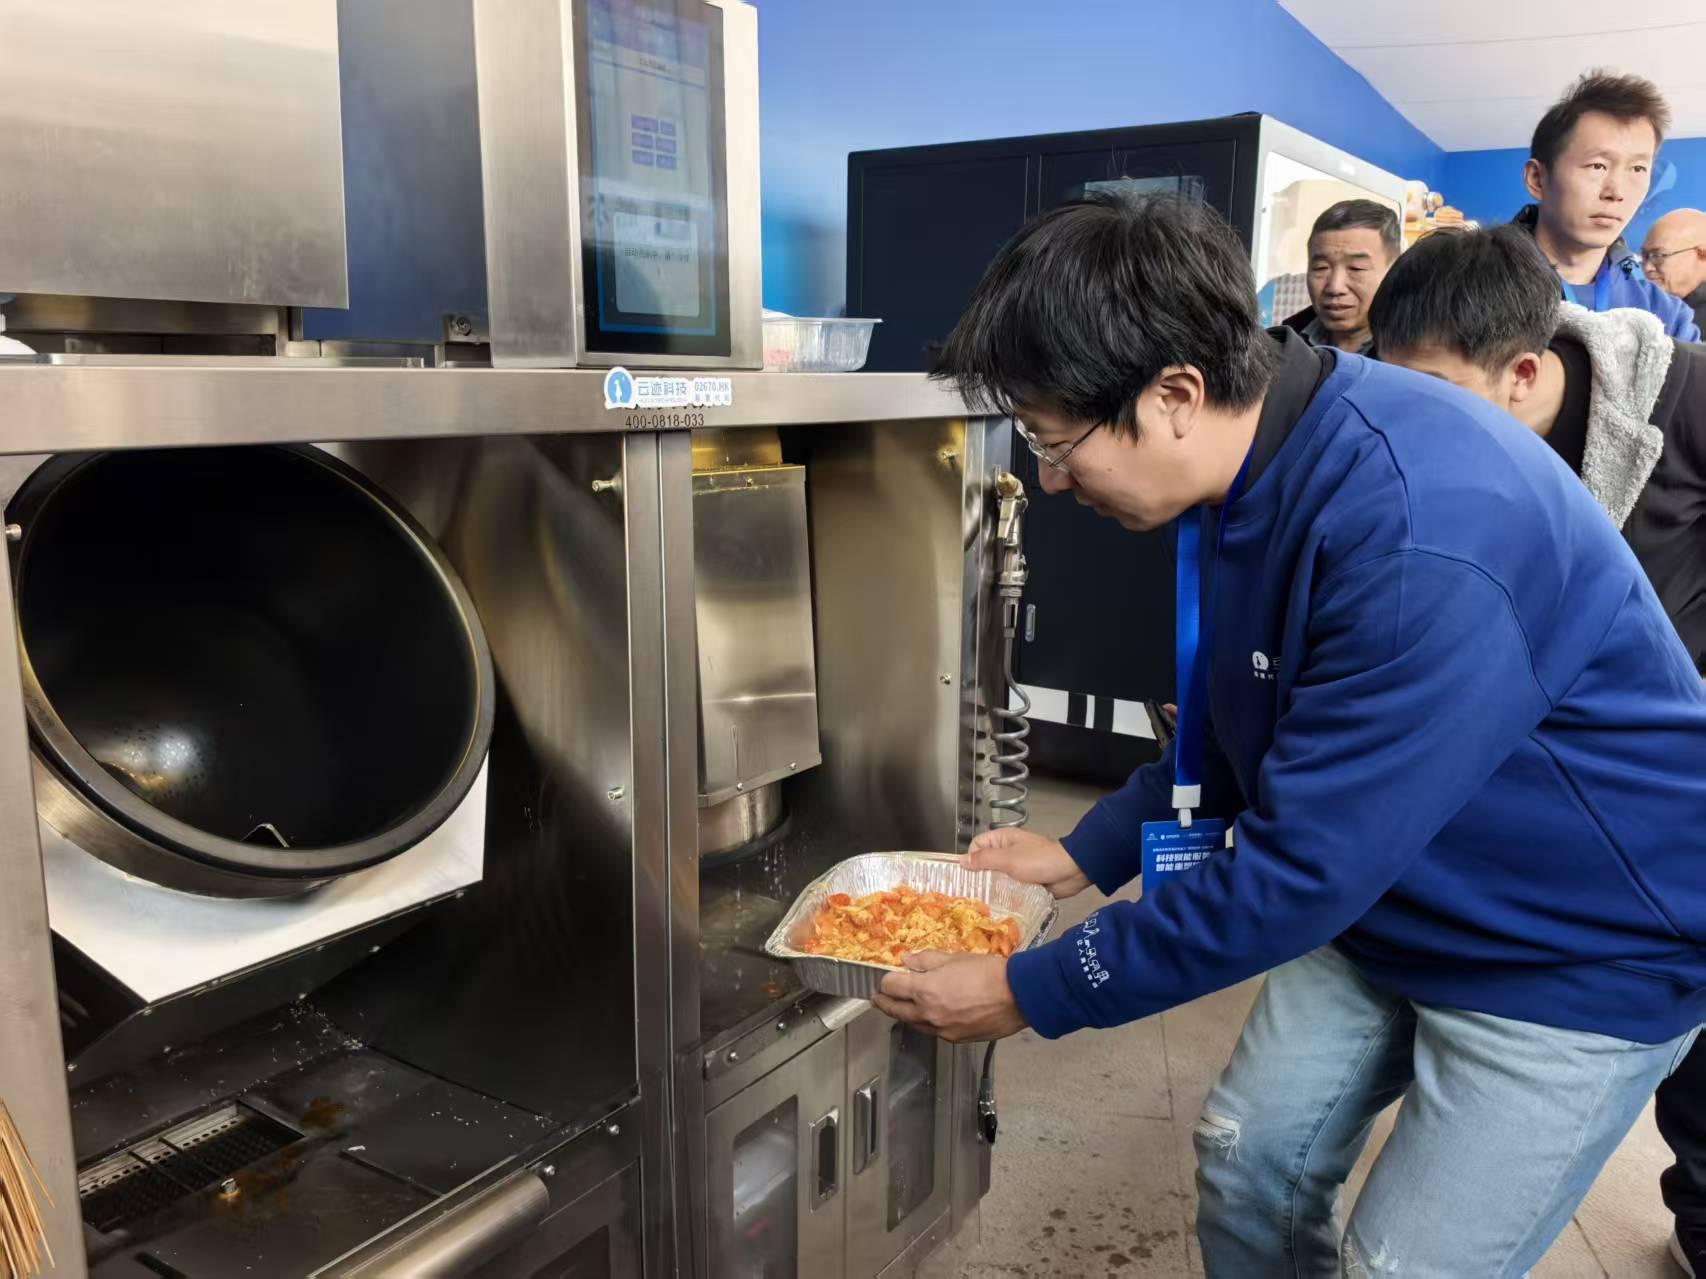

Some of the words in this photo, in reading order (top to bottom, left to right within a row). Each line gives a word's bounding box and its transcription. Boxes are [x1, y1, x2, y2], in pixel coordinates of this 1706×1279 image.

[638, 381, 688, 396] 云迹科技
[625, 413, 704, 428] 400-0818-033
